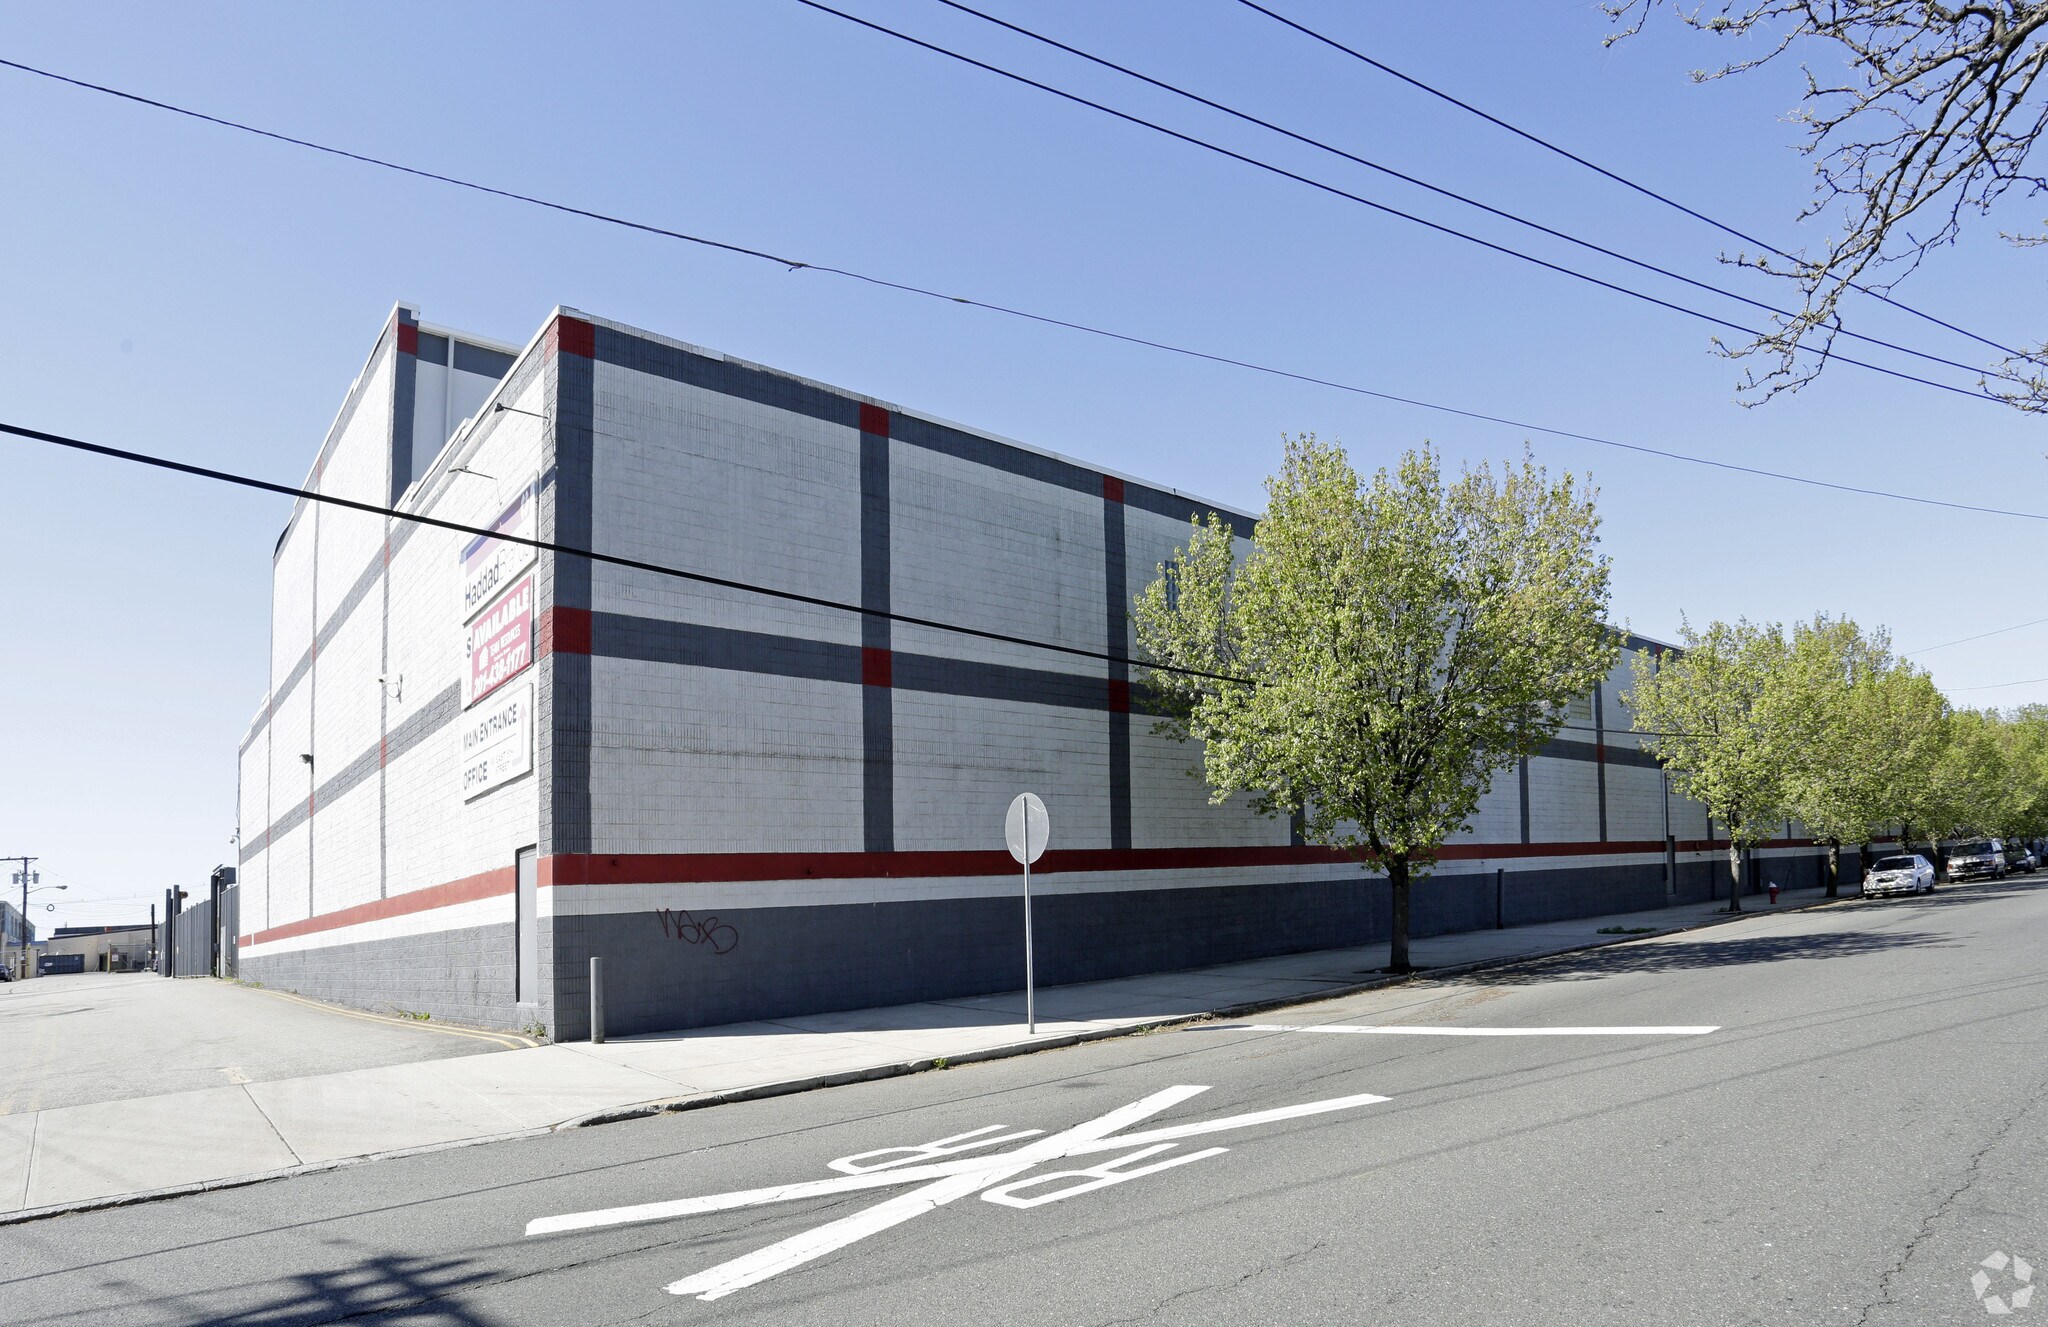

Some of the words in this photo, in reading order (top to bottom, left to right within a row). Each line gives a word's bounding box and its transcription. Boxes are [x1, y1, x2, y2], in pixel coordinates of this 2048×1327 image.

[464, 553, 499, 612] Haddad
[472, 585, 529, 652] AVAILABLE
[463, 728, 479, 751] MAIN
[479, 703, 517, 743] ENTRANCE
[463, 760, 488, 791] OFFICE
